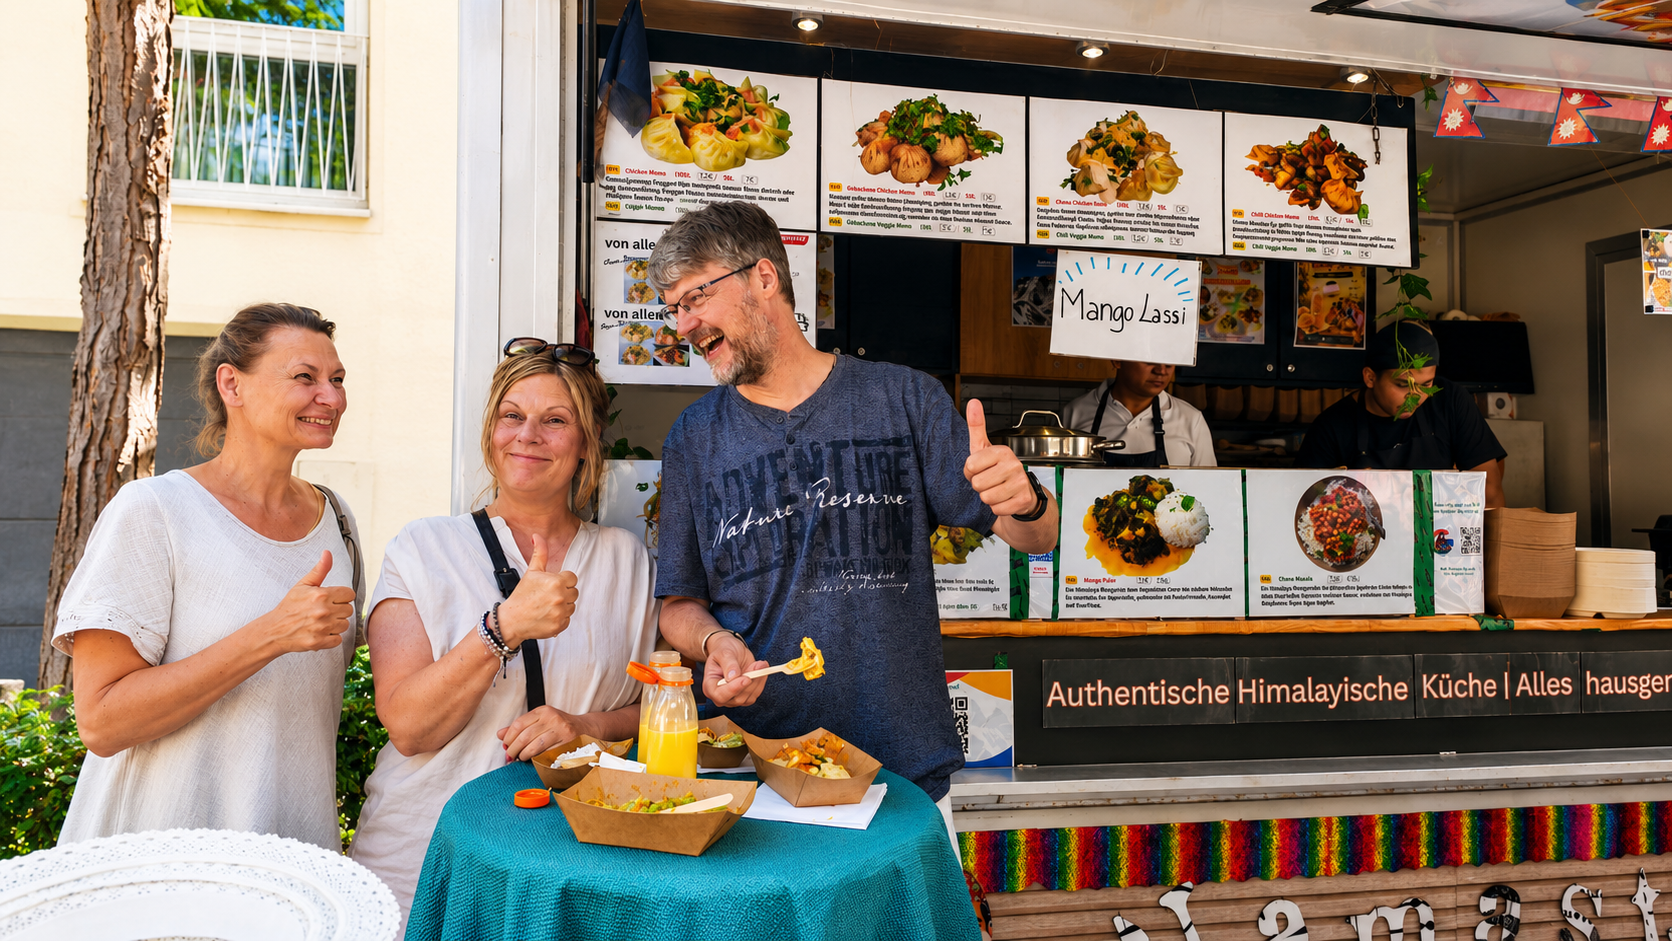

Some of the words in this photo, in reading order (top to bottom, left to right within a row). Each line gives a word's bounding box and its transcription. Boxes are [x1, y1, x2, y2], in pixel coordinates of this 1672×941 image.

[604, 239, 629, 249] von
[604, 309, 629, 319] von
[1060, 287, 1134, 333] Mango
[1139, 293, 1186, 325] Lassi
[704, 441, 912, 541] ADVENTURE
[712, 505, 794, 549] Nature
[1046, 678, 1230, 707] Authentische
[1238, 675, 1409, 709] Himalayische
[1422, 671, 1498, 699] Küche
[1515, 670, 1574, 697] Alles
